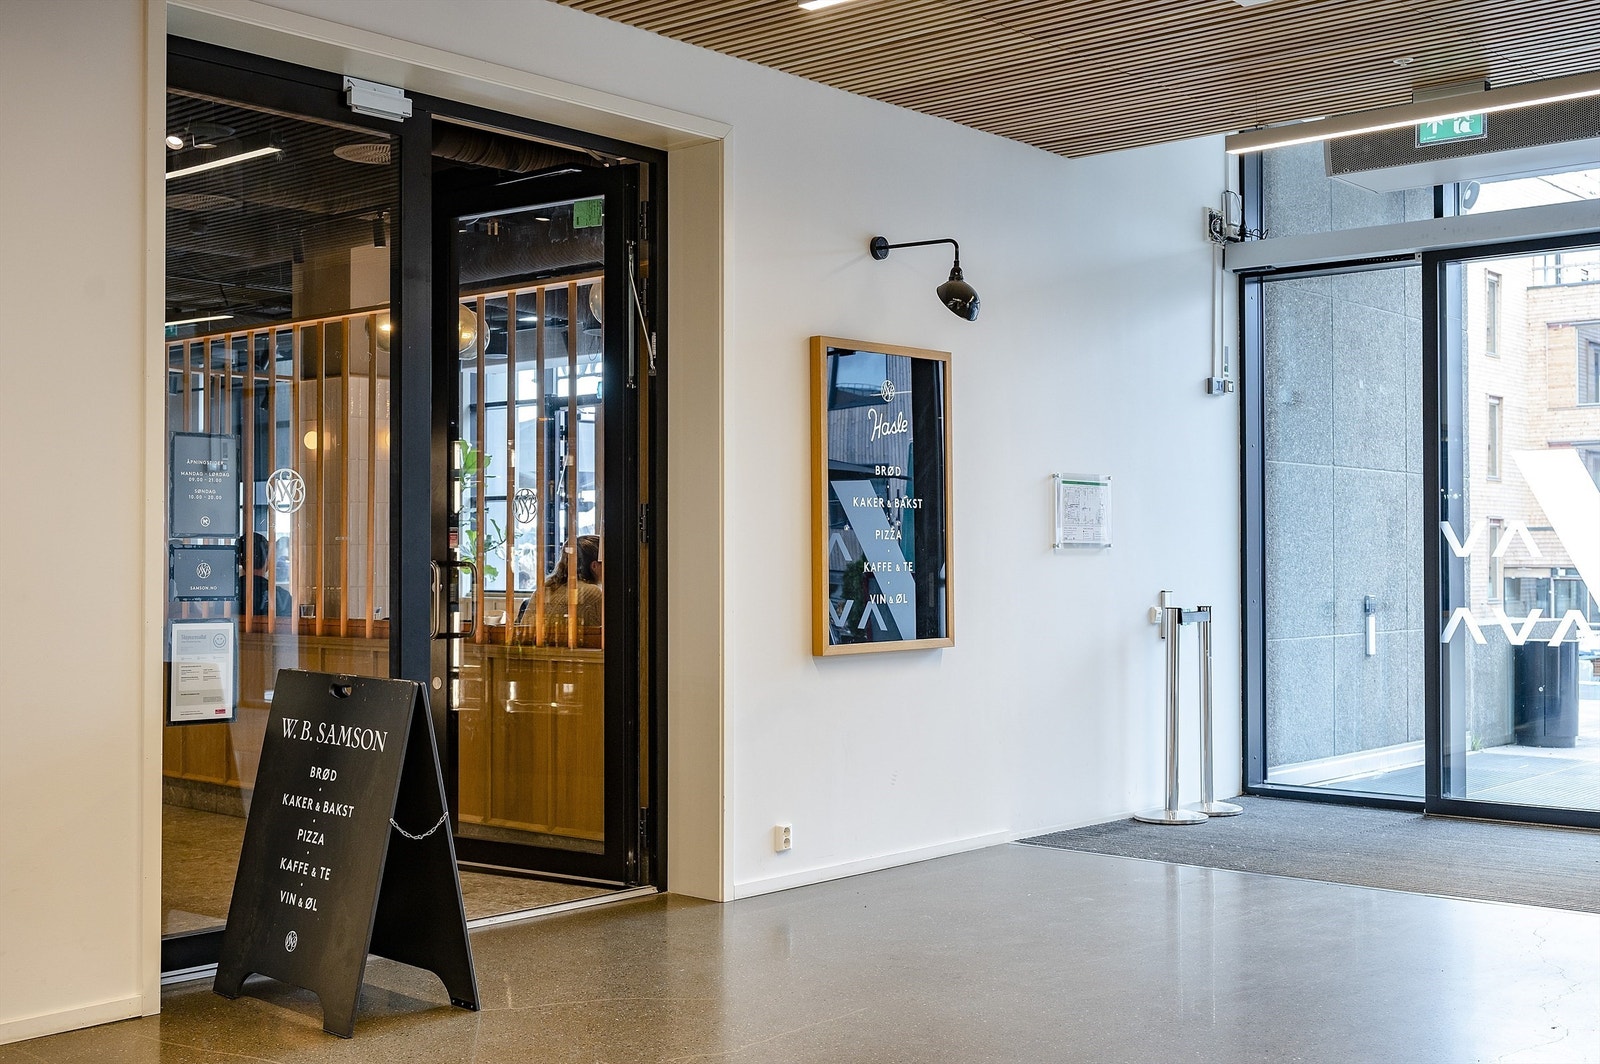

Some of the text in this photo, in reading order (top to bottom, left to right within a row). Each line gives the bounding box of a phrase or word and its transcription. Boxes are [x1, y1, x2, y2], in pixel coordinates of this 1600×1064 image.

[868, 408, 908, 441] Hasle
[875, 465, 901, 476] BRØD
[853, 497, 884, 508] KAKER
[894, 498, 923, 509] BAKST
[875, 530, 902, 540] PIZZA
[863, 562, 914, 572] KAFFE & TE
[870, 594, 886, 604] VIN
[895, 594, 908, 604] ØL
[282, 717, 388, 752] W. B. SAMSON
[309, 766, 337, 782] BRØD
[282, 793, 354, 818] KAKER & BAKST
[297, 828, 325, 846] PIZZA
[280, 857, 332, 881] KAFFE & TE
[280, 890, 318, 912] VIN & ØL
